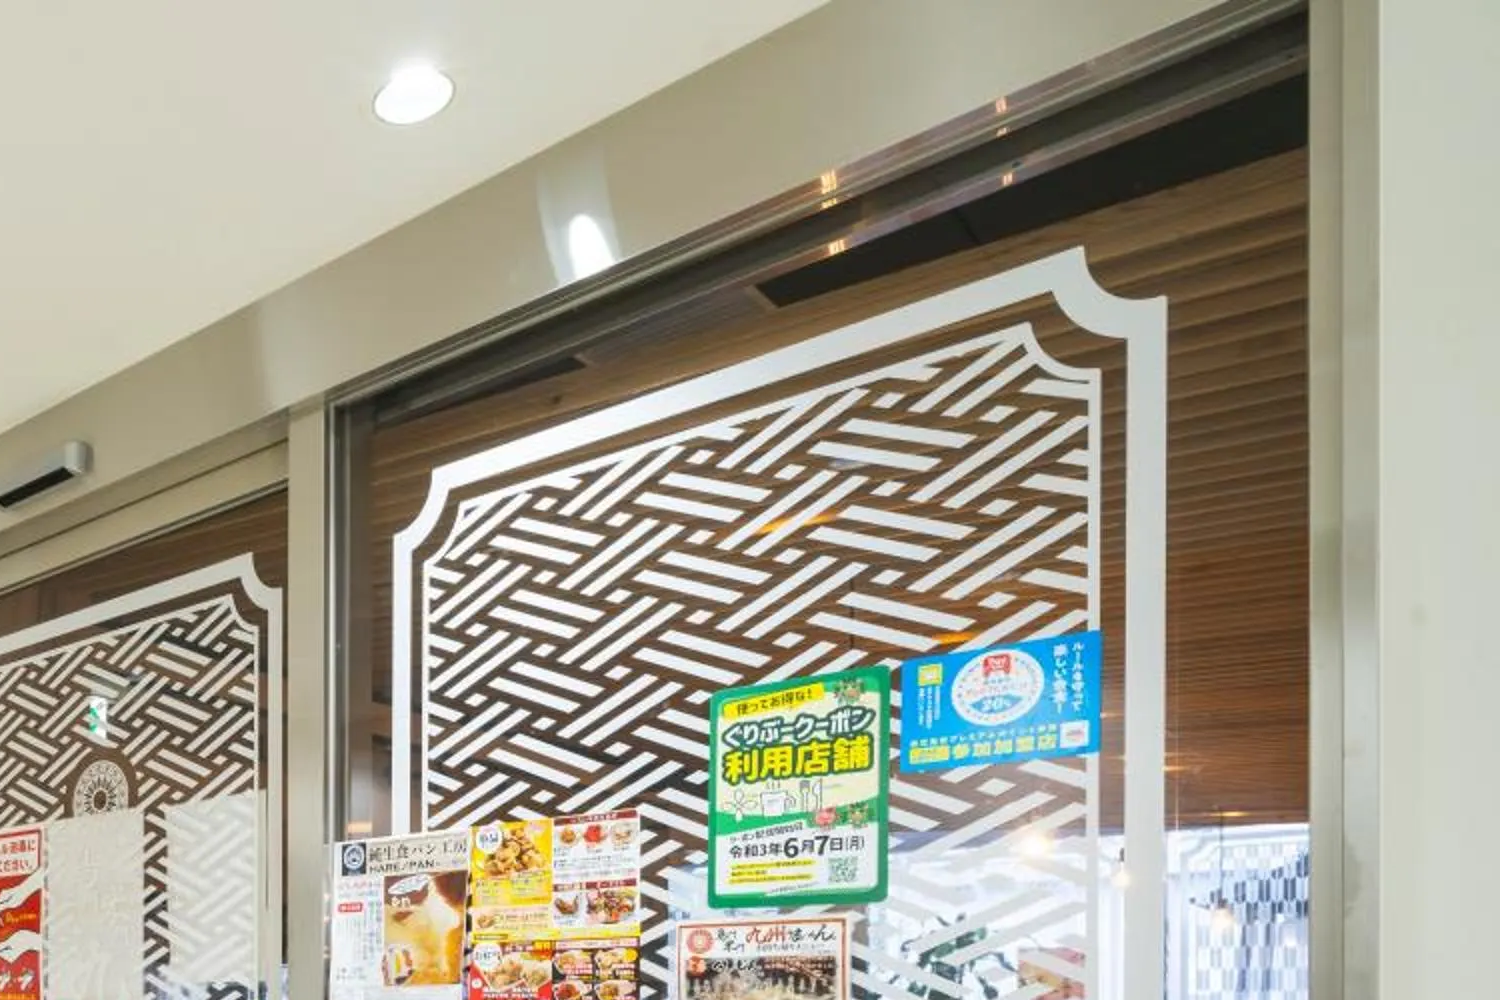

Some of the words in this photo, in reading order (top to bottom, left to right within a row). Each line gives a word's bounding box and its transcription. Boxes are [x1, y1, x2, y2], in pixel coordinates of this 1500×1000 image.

[723, 734, 873, 784] 利用店舗
[729, 834, 865, 859] 令和3年6月7日(月)
